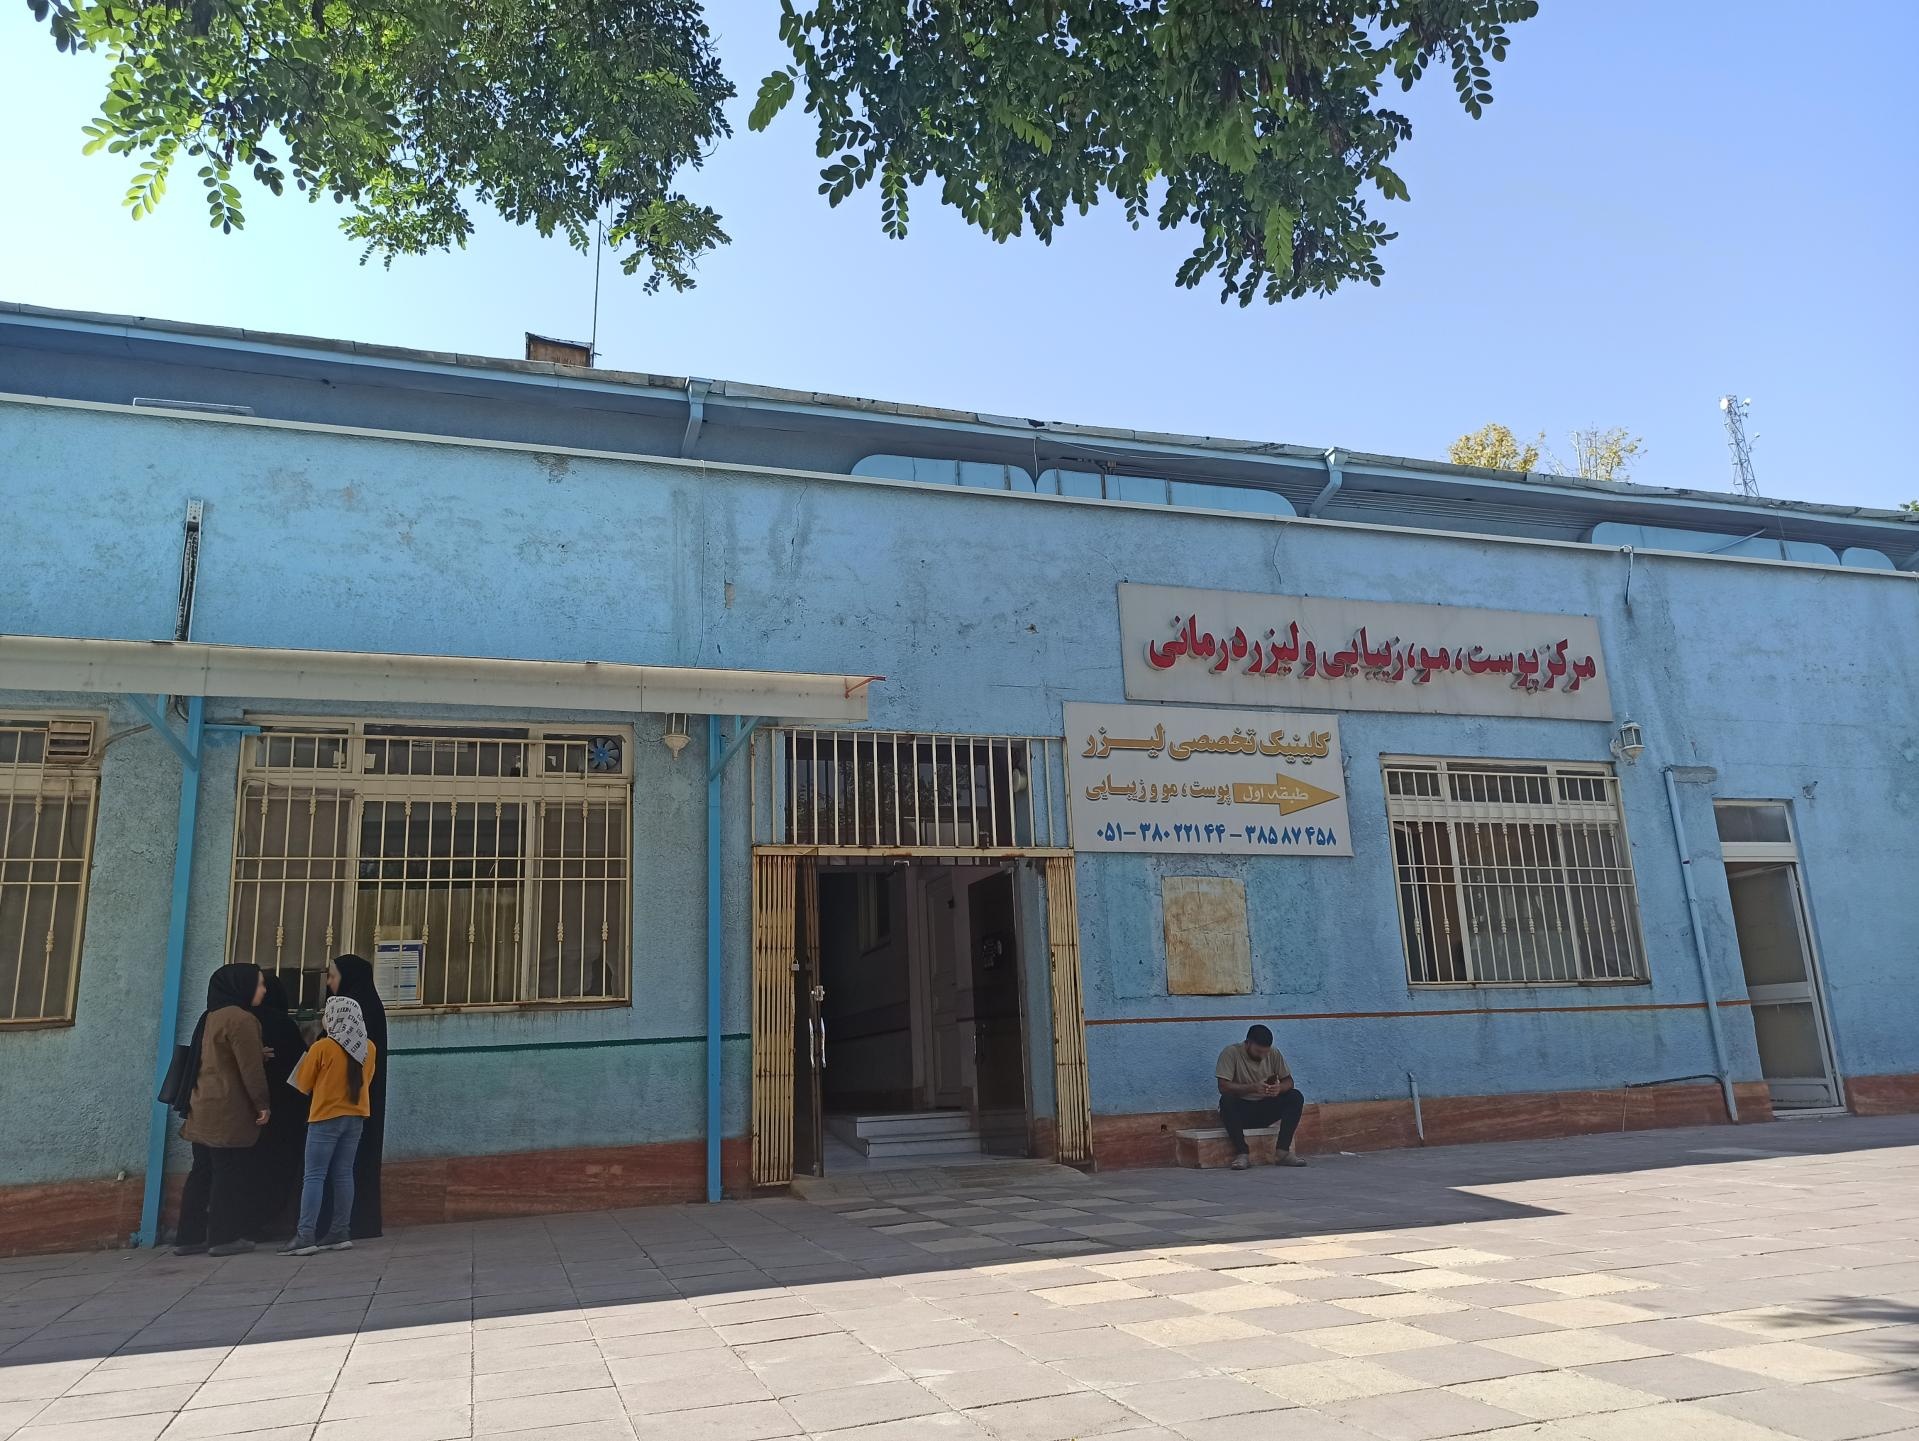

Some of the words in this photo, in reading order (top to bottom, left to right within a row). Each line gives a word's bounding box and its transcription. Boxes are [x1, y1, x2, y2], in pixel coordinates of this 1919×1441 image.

[1149, 613, 1248, 672] درمانی
[1247, 620, 1300, 676] لیزر
[1301, 639, 1317, 678] و
[1322, 625, 1405, 682] زیبایی
[1543, 638, 1597, 691] مرکز
[1081, 722, 1165, 758] لیزر
[1168, 727, 1257, 761] تخصصی
[1259, 729, 1331, 765] کلینیک
[1085, 773, 1147, 802] زیبایی
[1149, 782, 1159, 802] و
[1160, 782, 1178, 803] مو
[1242, 785, 1264, 802] اول
[1267, 785, 1309, 804] طبقه
